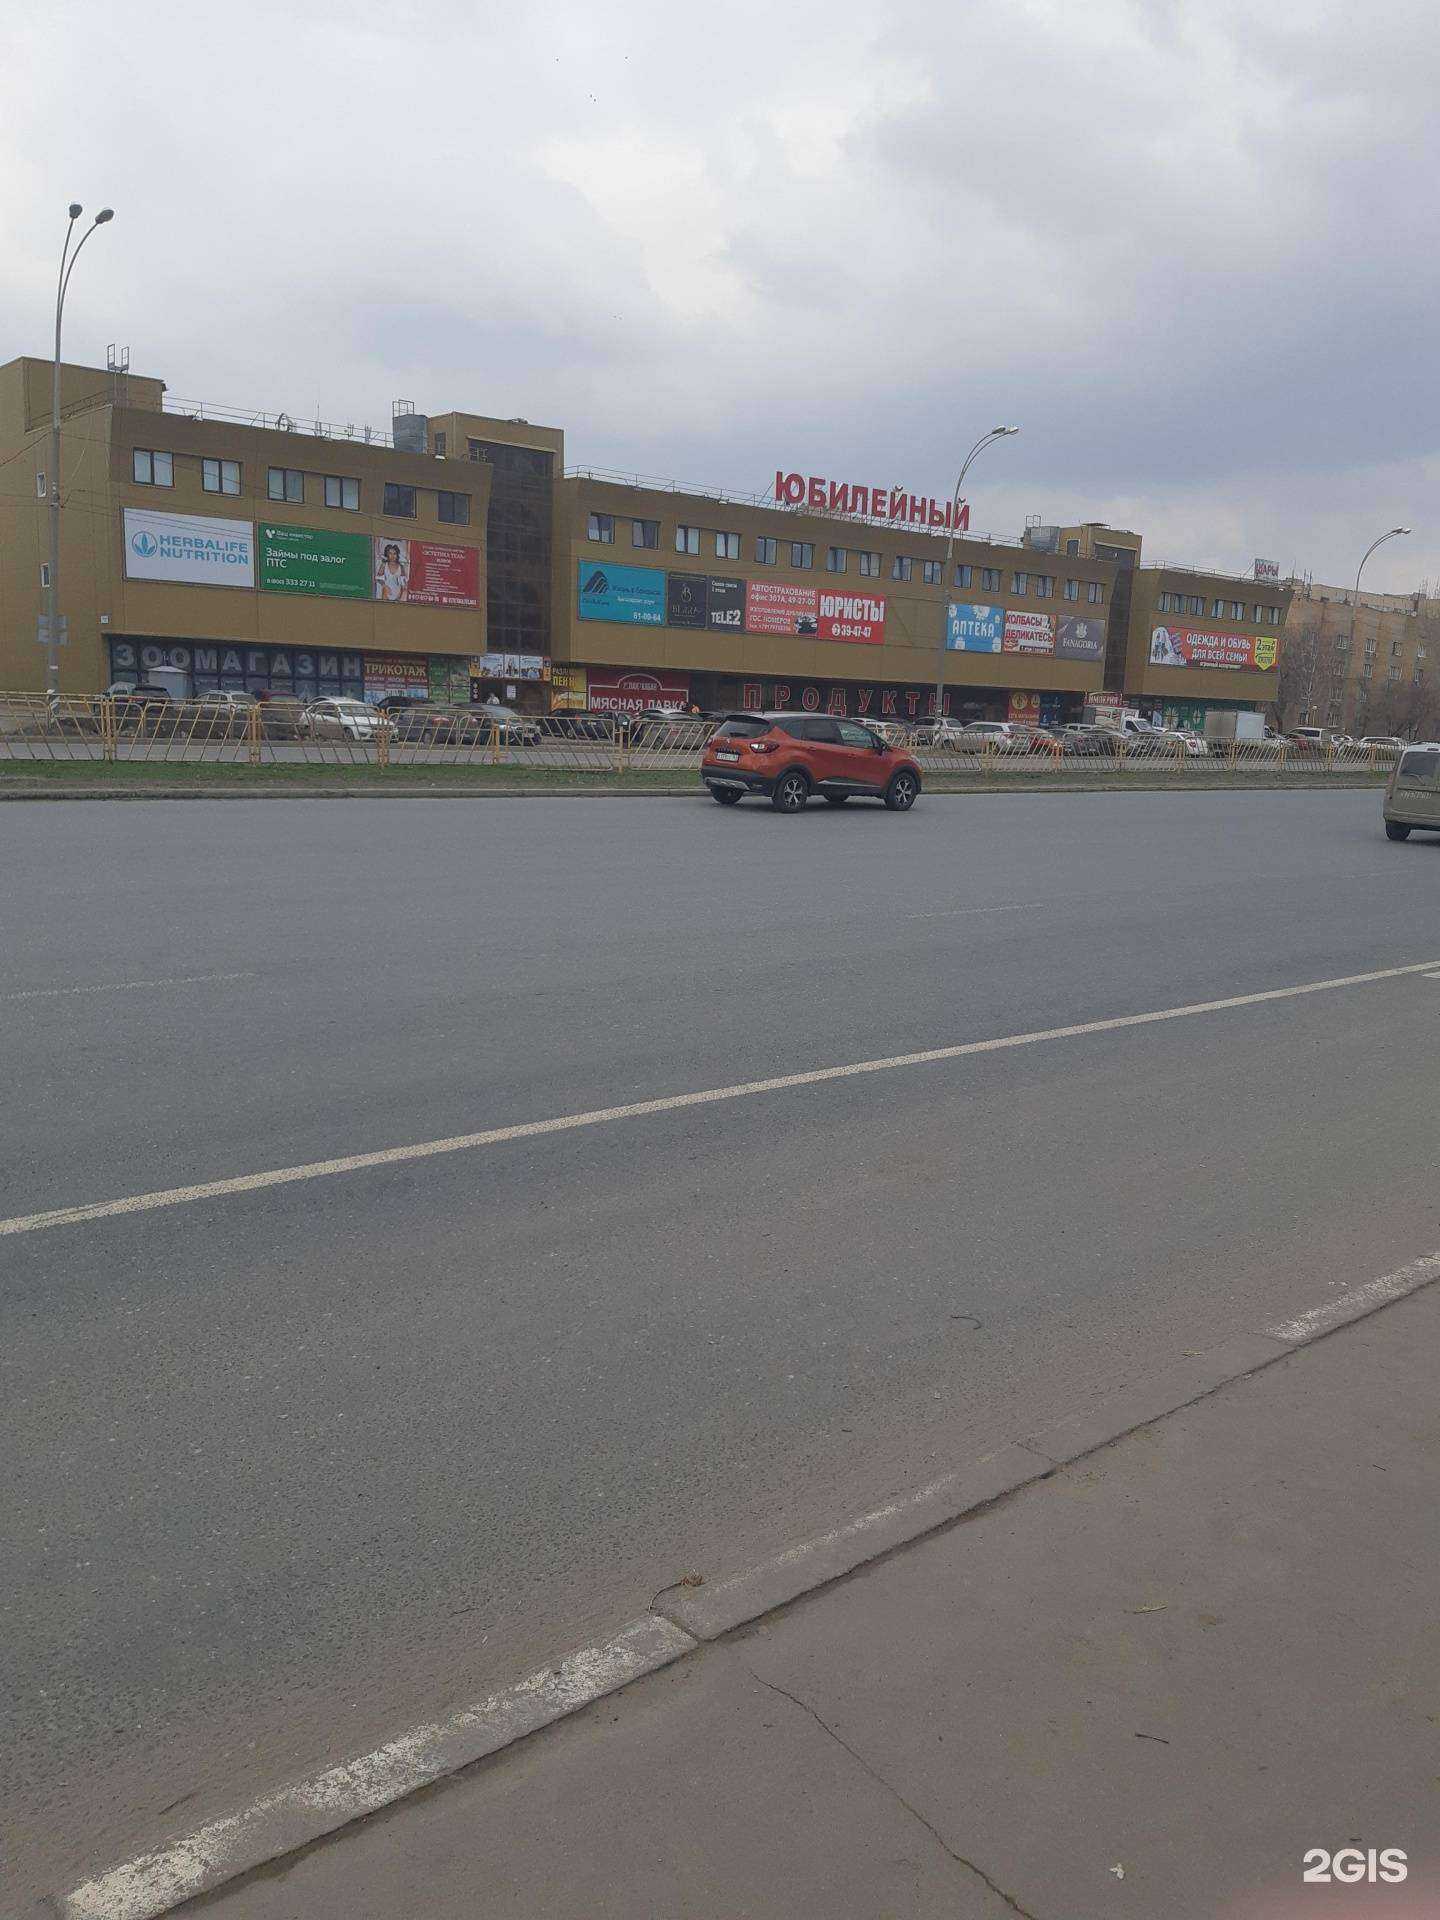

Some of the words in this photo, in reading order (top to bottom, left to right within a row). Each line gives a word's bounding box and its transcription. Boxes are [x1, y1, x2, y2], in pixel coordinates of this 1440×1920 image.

[775, 470, 970, 531] ЮБИЛЕЙНЫЙ
[160, 534, 248, 553] HERBALIFE
[160, 547, 249, 565] NUTRITION
[266, 547, 298, 559] Займы
[300, 553, 319, 562] под
[320, 555, 347, 564] залог
[266, 558, 287, 568] ПТС
[751, 583, 816, 598] АВТОСТРАХОВАНИЕ
[820, 595, 885, 622] ЮРИСТЫ
[711, 610, 741, 625] TELE2
[1006, 614, 1042, 627] КОЛБАСЫ
[841, 626, 872, 638] 39-47-47
[952, 620, 995, 637] АПТЕКА
[1063, 637, 1097, 650] FANAGORIA
[1186, 632, 1219, 647] ОДЕЖДА
[1220, 638, 1226, 647] И
[1227, 638, 1251, 650] ОБУВЬ
[115, 644, 361, 677] ЗООМАГАЗИН
[1191, 648, 1207, 660] ДЛЯ
[1207, 650, 1224, 661] ВСЕЙ
[1225, 651, 1248, 662] СЕМЬИ
[364, 663, 426, 677] ТРИКОТАЖ
[591, 696, 643, 711] МЯСНАЯ
[744, 684, 951, 716] ПРОДУКТЫ
